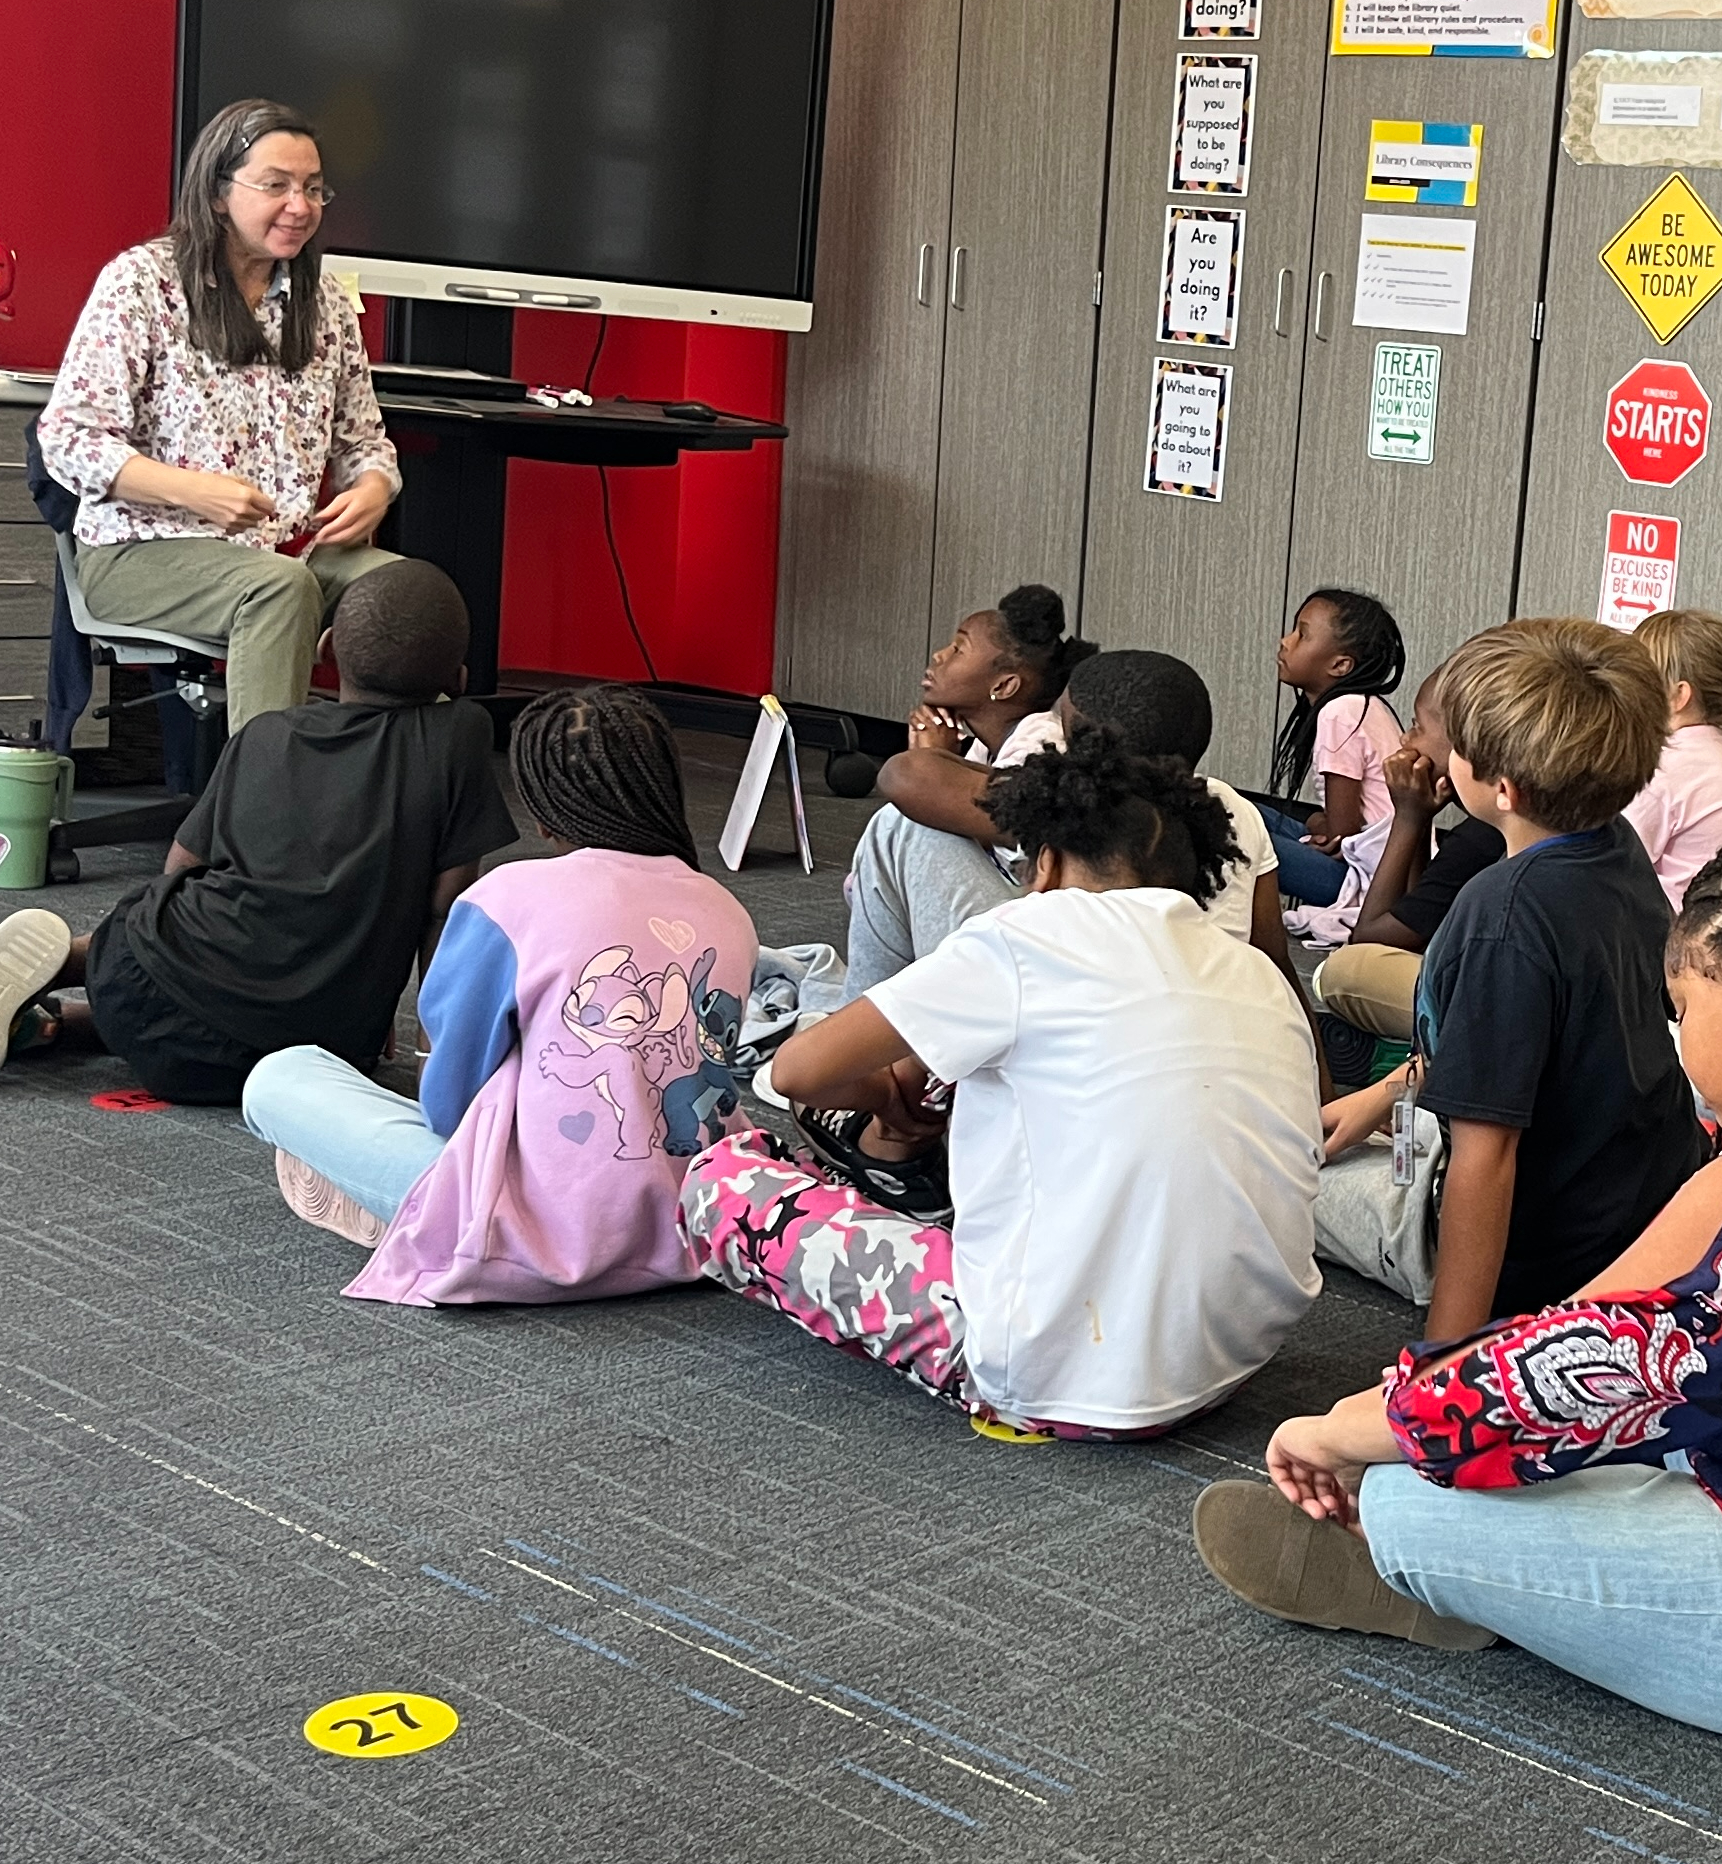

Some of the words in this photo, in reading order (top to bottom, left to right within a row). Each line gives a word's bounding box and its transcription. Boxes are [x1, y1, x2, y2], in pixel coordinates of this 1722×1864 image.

[1195, 0, 1247, 19] doing?
[1363, 3, 1376, 12] will
[1378, 4, 1396, 13] keep
[1412, 4, 1438, 14] library
[1413, 15, 1439, 25] library
[1478, 16, 1525, 25] procedures.
[1188, 74, 1220, 89] What
[1222, 79, 1242, 90] are
[1203, 99, 1225, 112] you
[1186, 117, 1240, 133] supposed
[1197, 138, 1209, 150] to
[1211, 136, 1226, 151] be
[1189, 156, 1230, 175] doing?
[1375, 154, 1407, 168] Library
[1409, 156, 1473, 170] Consequences
[1661, 213, 1686, 237] BE
[1190, 227, 1218, 245] Are
[1188, 256, 1216, 274] you
[1625, 243, 1716, 268] AWESOME
[1180, 278, 1221, 302] doing
[1639, 273, 1698, 298] TODAY
[1189, 304, 1208, 322] it?
[1381, 350, 1435, 378] TREAT
[1165, 378, 1196, 396] What
[1198, 386, 1217, 398] are
[1378, 377, 1432, 400] OTHERS
[1643, 387, 1679, 401] KINDNESS
[1179, 403, 1201, 417] you
[1376, 397, 1404, 416] HOW
[1406, 400, 1431, 419] YOU
[1164, 420, 1197, 438] going
[1199, 424, 1211, 437] to
[1611, 400, 1703, 448] STARTS
[1161, 437, 1176, 452] do
[1178, 441, 1211, 457] about
[1177, 459, 1192, 474] it?
[1626, 522, 1659, 553] NO
[1611, 558, 1669, 580] EXCUSES
[1612, 576, 1629, 595] BE
[1631, 579, 1663, 599] KIND
[1609, 612, 1623, 624] ALL
[1625, 614, 1639, 626] THE
[328, 1701, 424, 1748] 27
